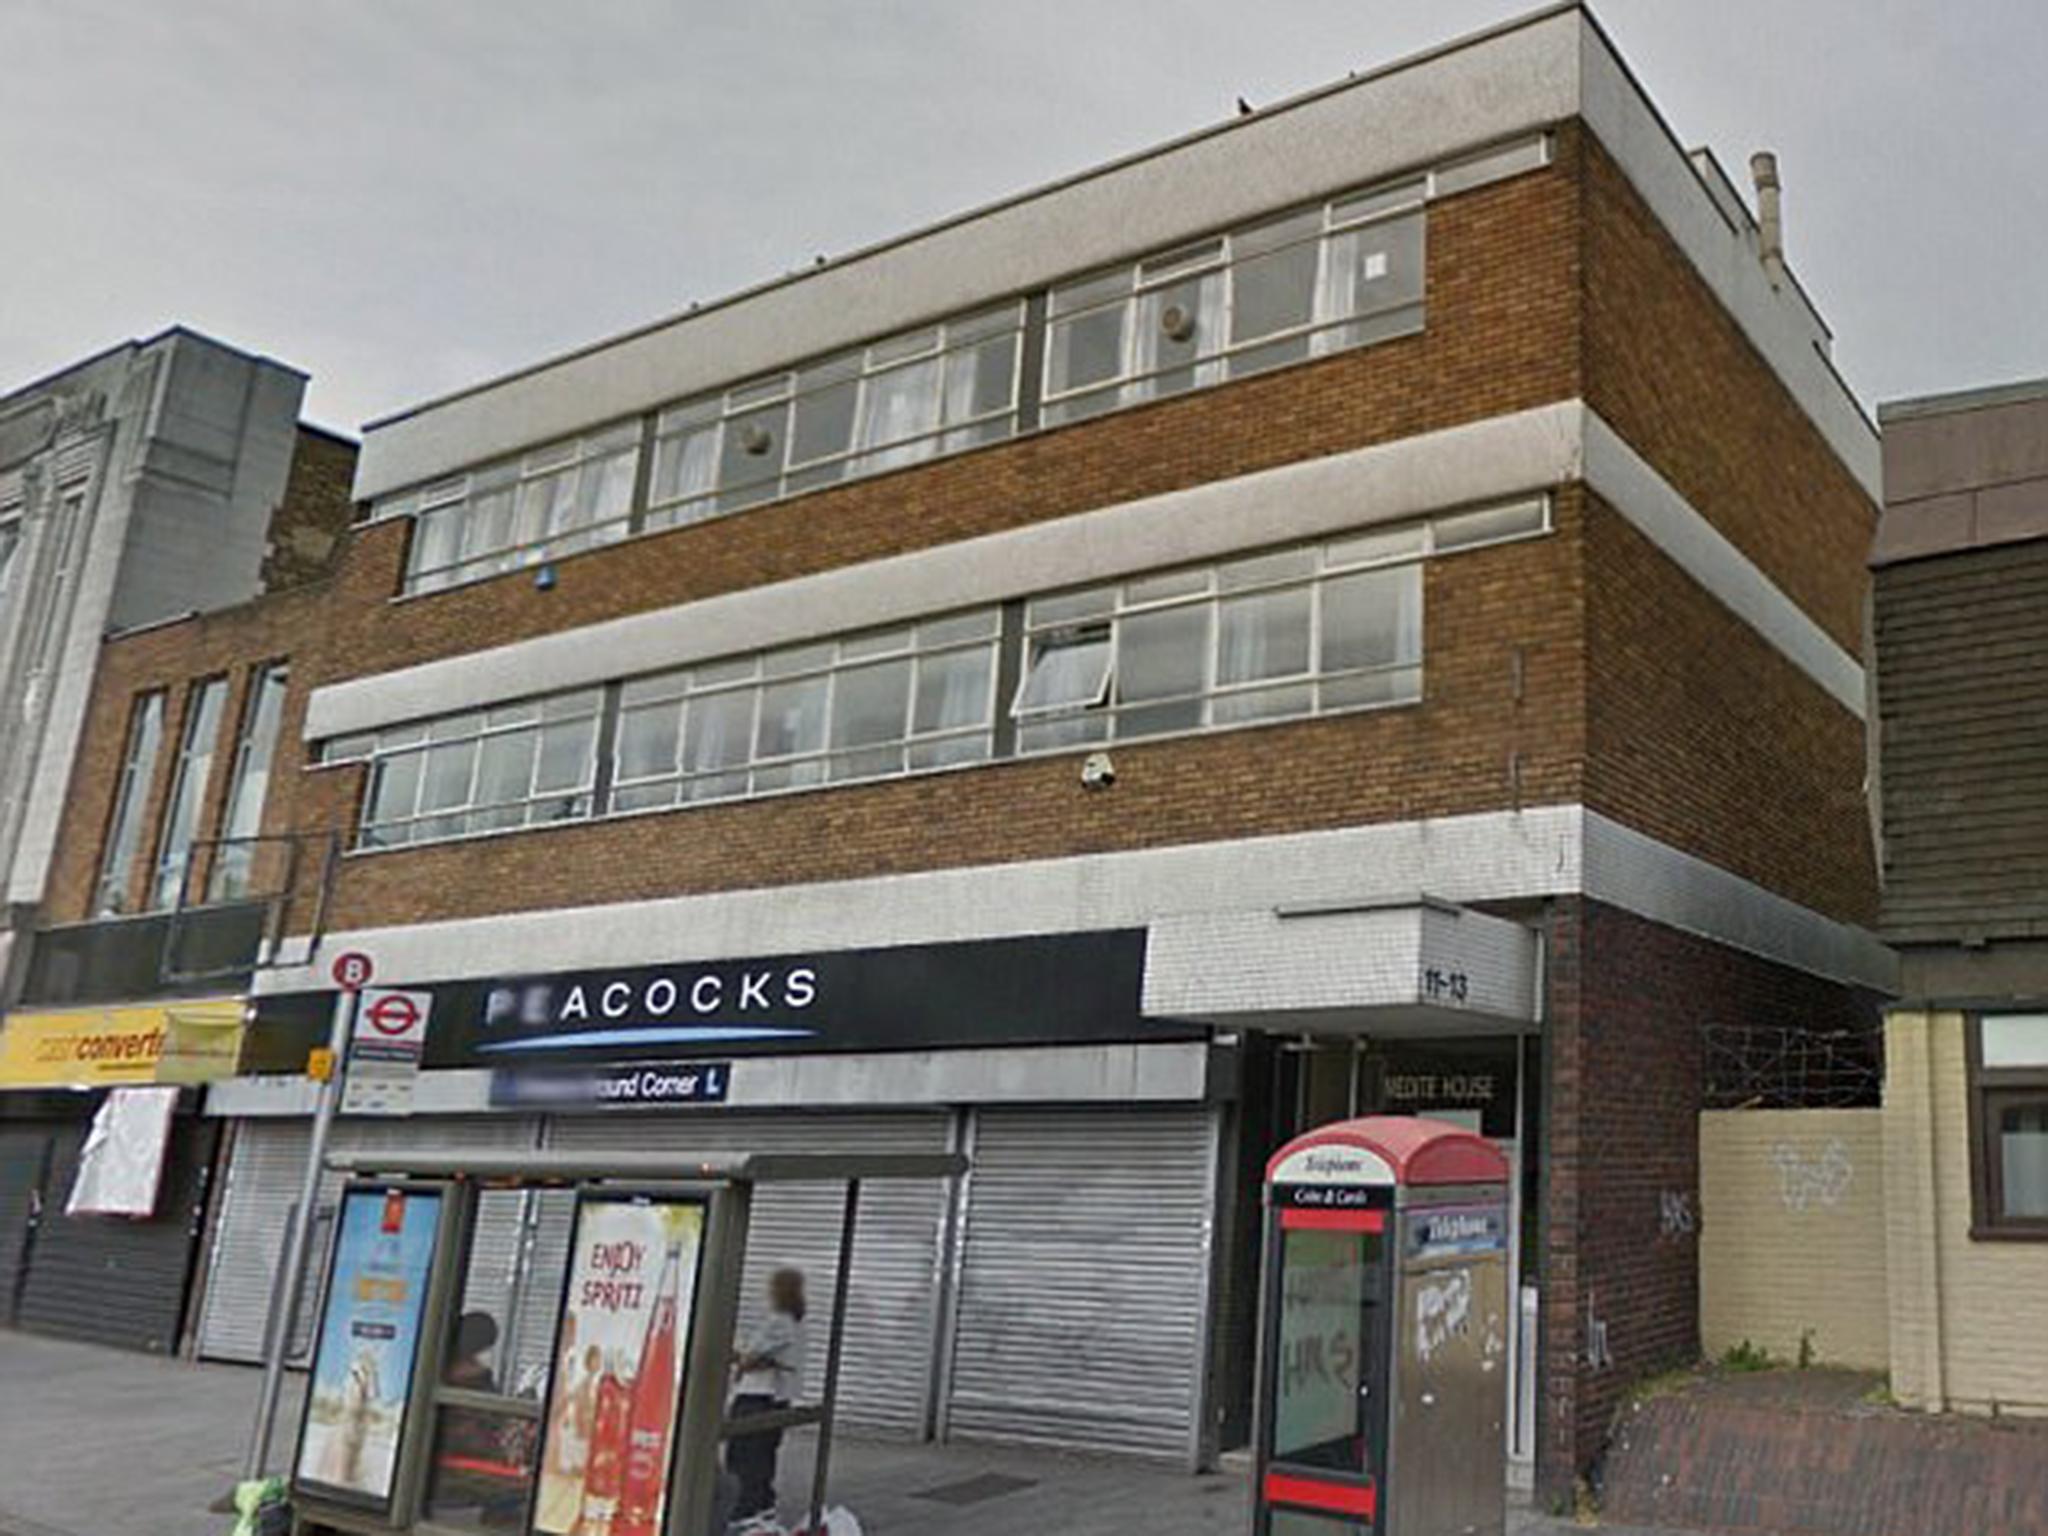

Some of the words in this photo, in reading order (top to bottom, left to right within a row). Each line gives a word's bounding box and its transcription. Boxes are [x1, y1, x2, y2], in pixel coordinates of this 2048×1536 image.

[345, 958, 364, 983] B
[1424, 968, 1469, 1000] 11-13
[485, 968, 817, 1025] PEACOCKS
[590, 1241, 647, 1277] ENJOY
[581, 1280, 644, 1311] SPRITZ
